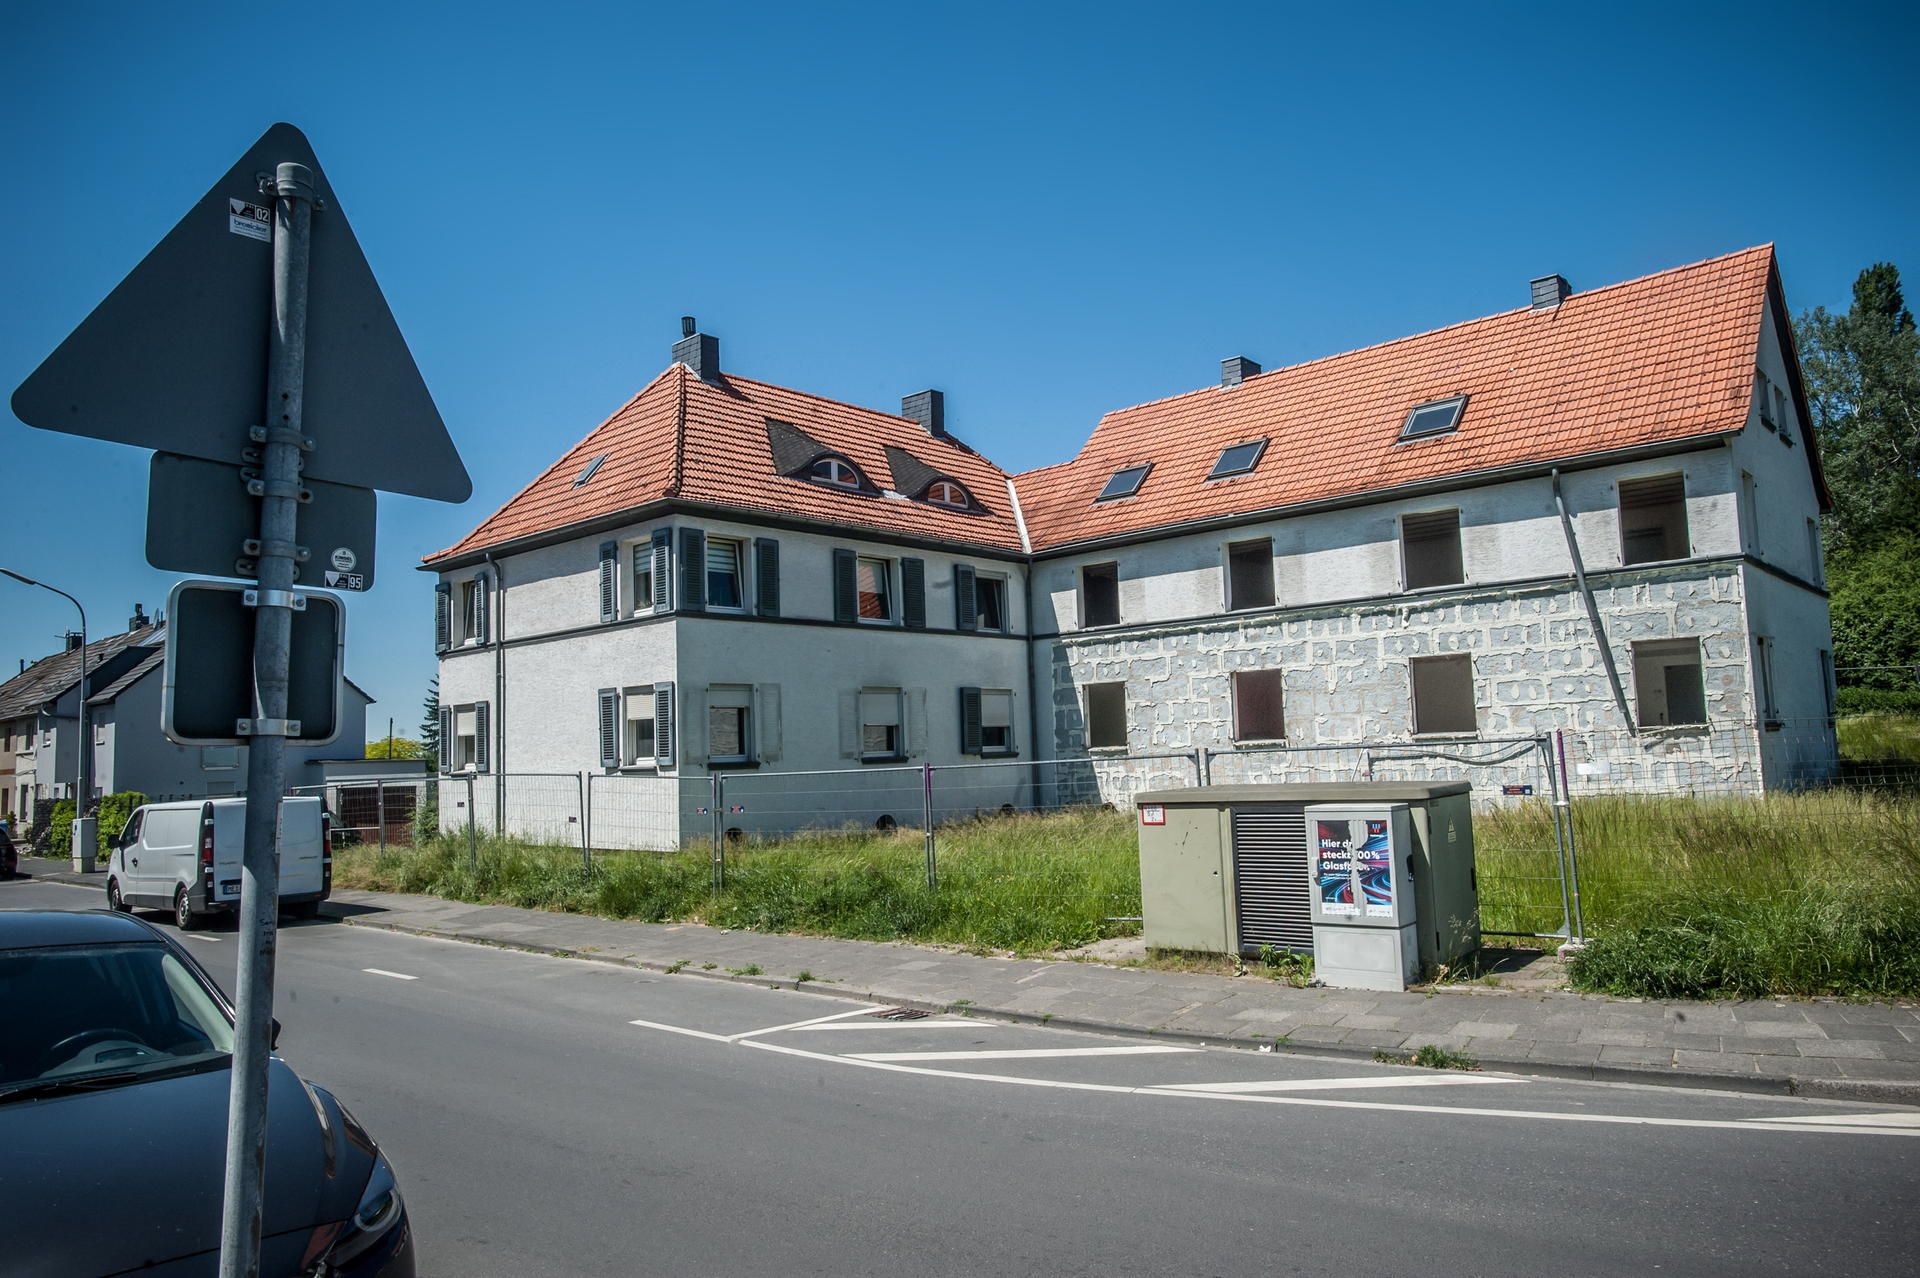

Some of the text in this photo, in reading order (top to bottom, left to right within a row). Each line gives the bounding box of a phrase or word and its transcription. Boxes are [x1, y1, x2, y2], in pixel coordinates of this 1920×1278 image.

[256, 208, 268, 221] 02
[350, 577, 361, 589] 95
[1322, 839, 1341, 848] Hier
[1323, 851, 1380, 860] steckt 00%
